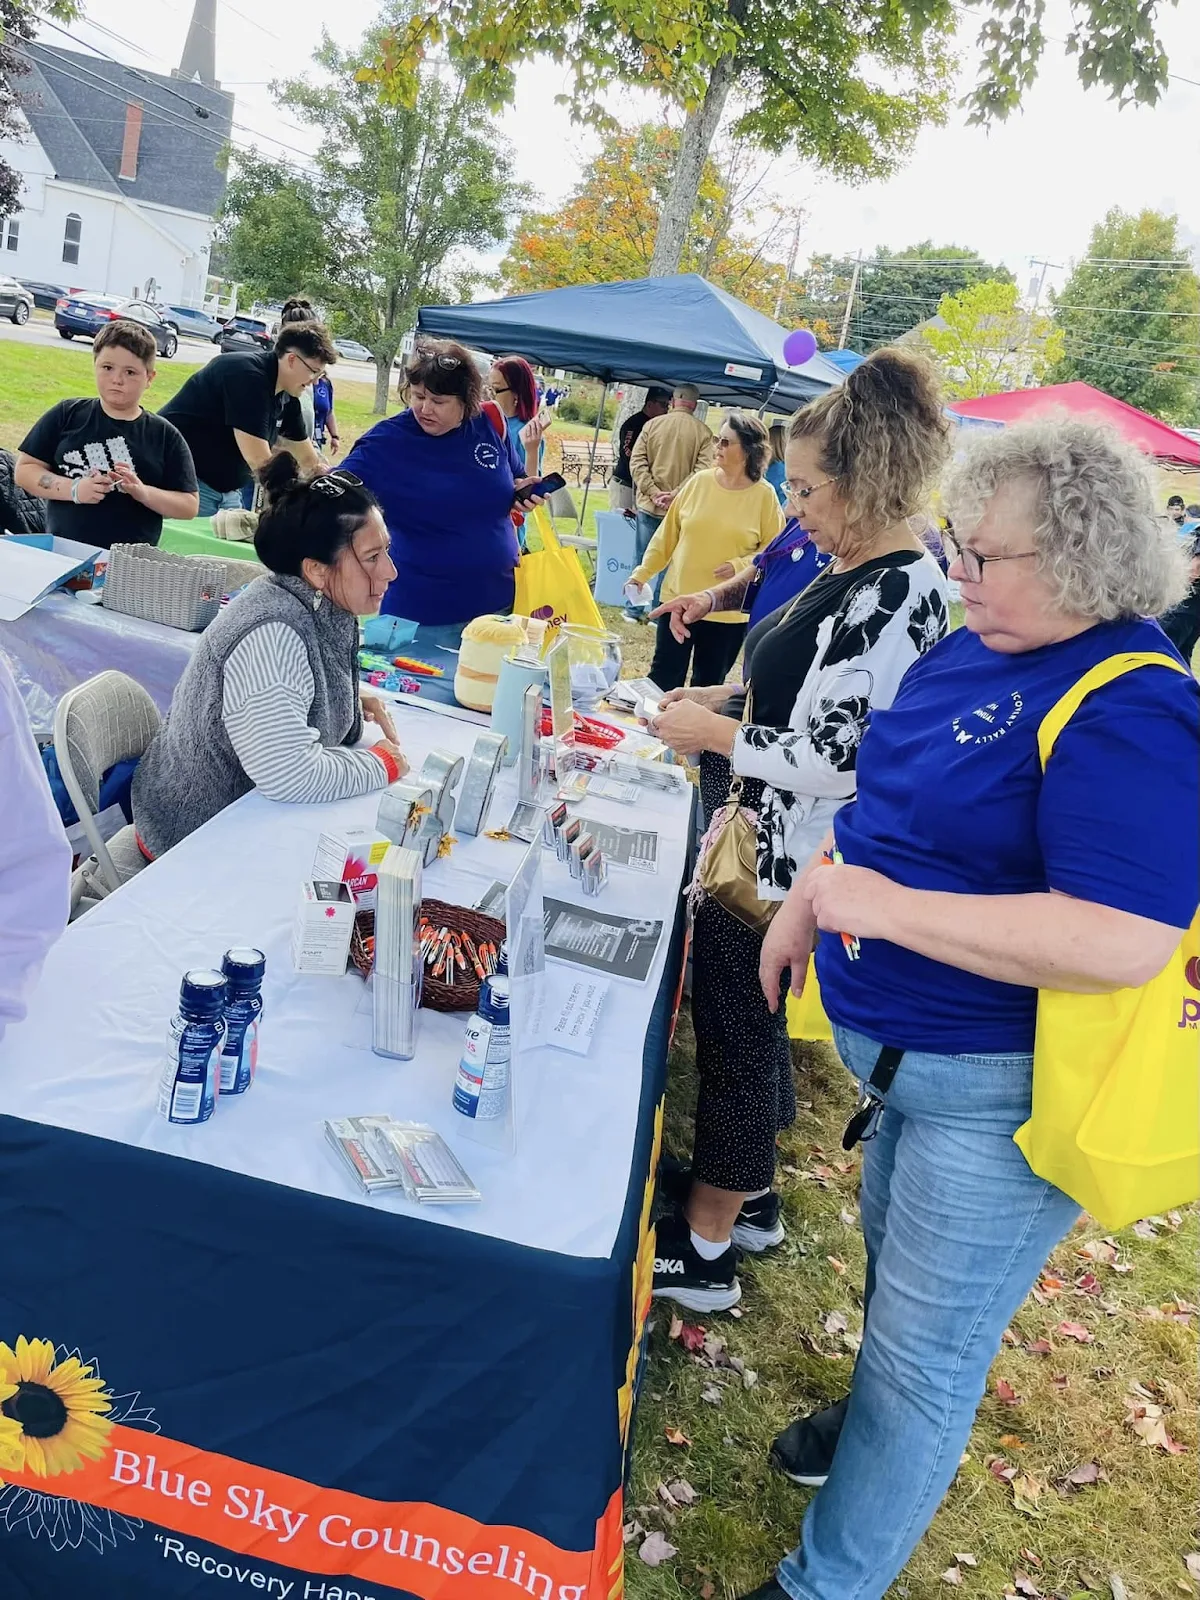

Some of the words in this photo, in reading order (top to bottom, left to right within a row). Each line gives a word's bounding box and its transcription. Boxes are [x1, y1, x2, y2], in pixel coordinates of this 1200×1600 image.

[975, 727, 1007, 745] RALLY
[344, 876, 369, 888] ARCAN
[653, 1257, 686, 1275] OKA
[109, 1448, 212, 1507] Blue
[223, 1484, 309, 1543] Sky
